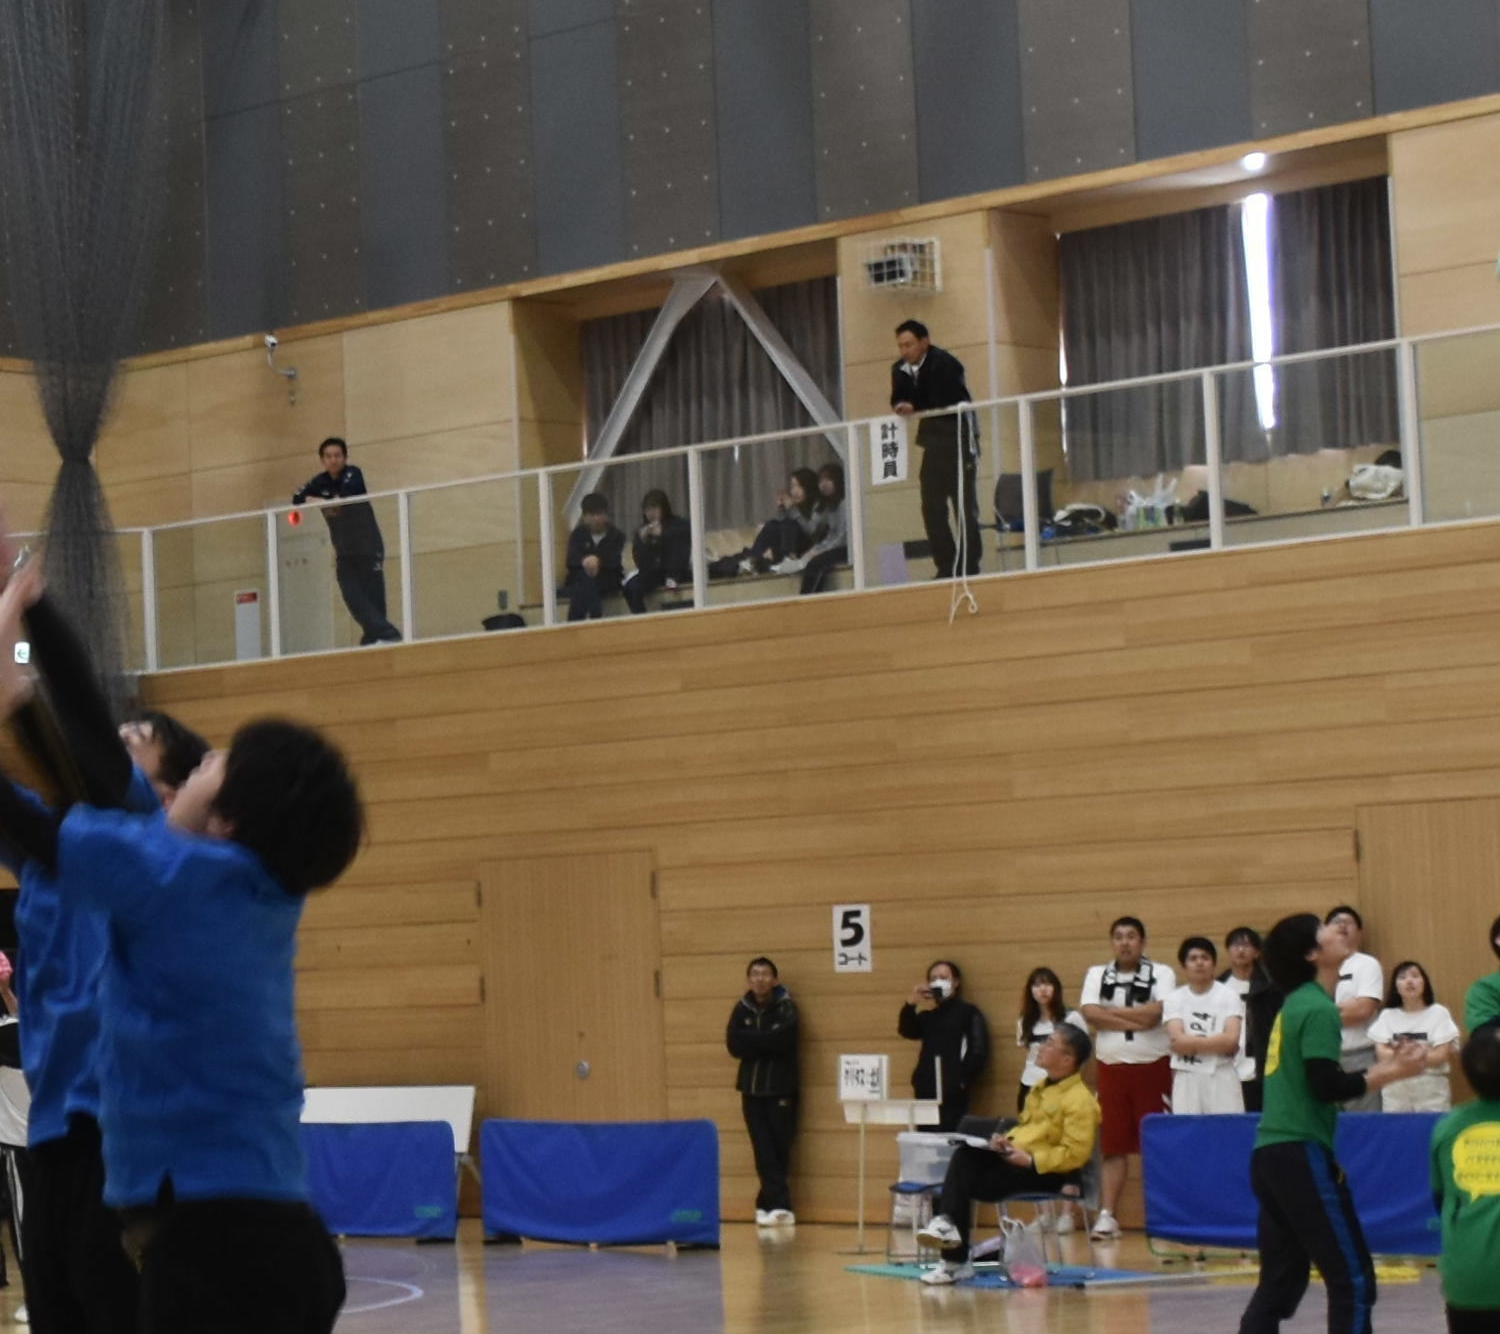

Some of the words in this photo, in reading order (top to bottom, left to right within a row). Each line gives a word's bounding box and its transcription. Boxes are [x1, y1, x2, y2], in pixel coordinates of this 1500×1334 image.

[881, 422, 899, 479] 計時員
[840, 910, 864, 947] 5
[838, 953, 867, 966] コート
